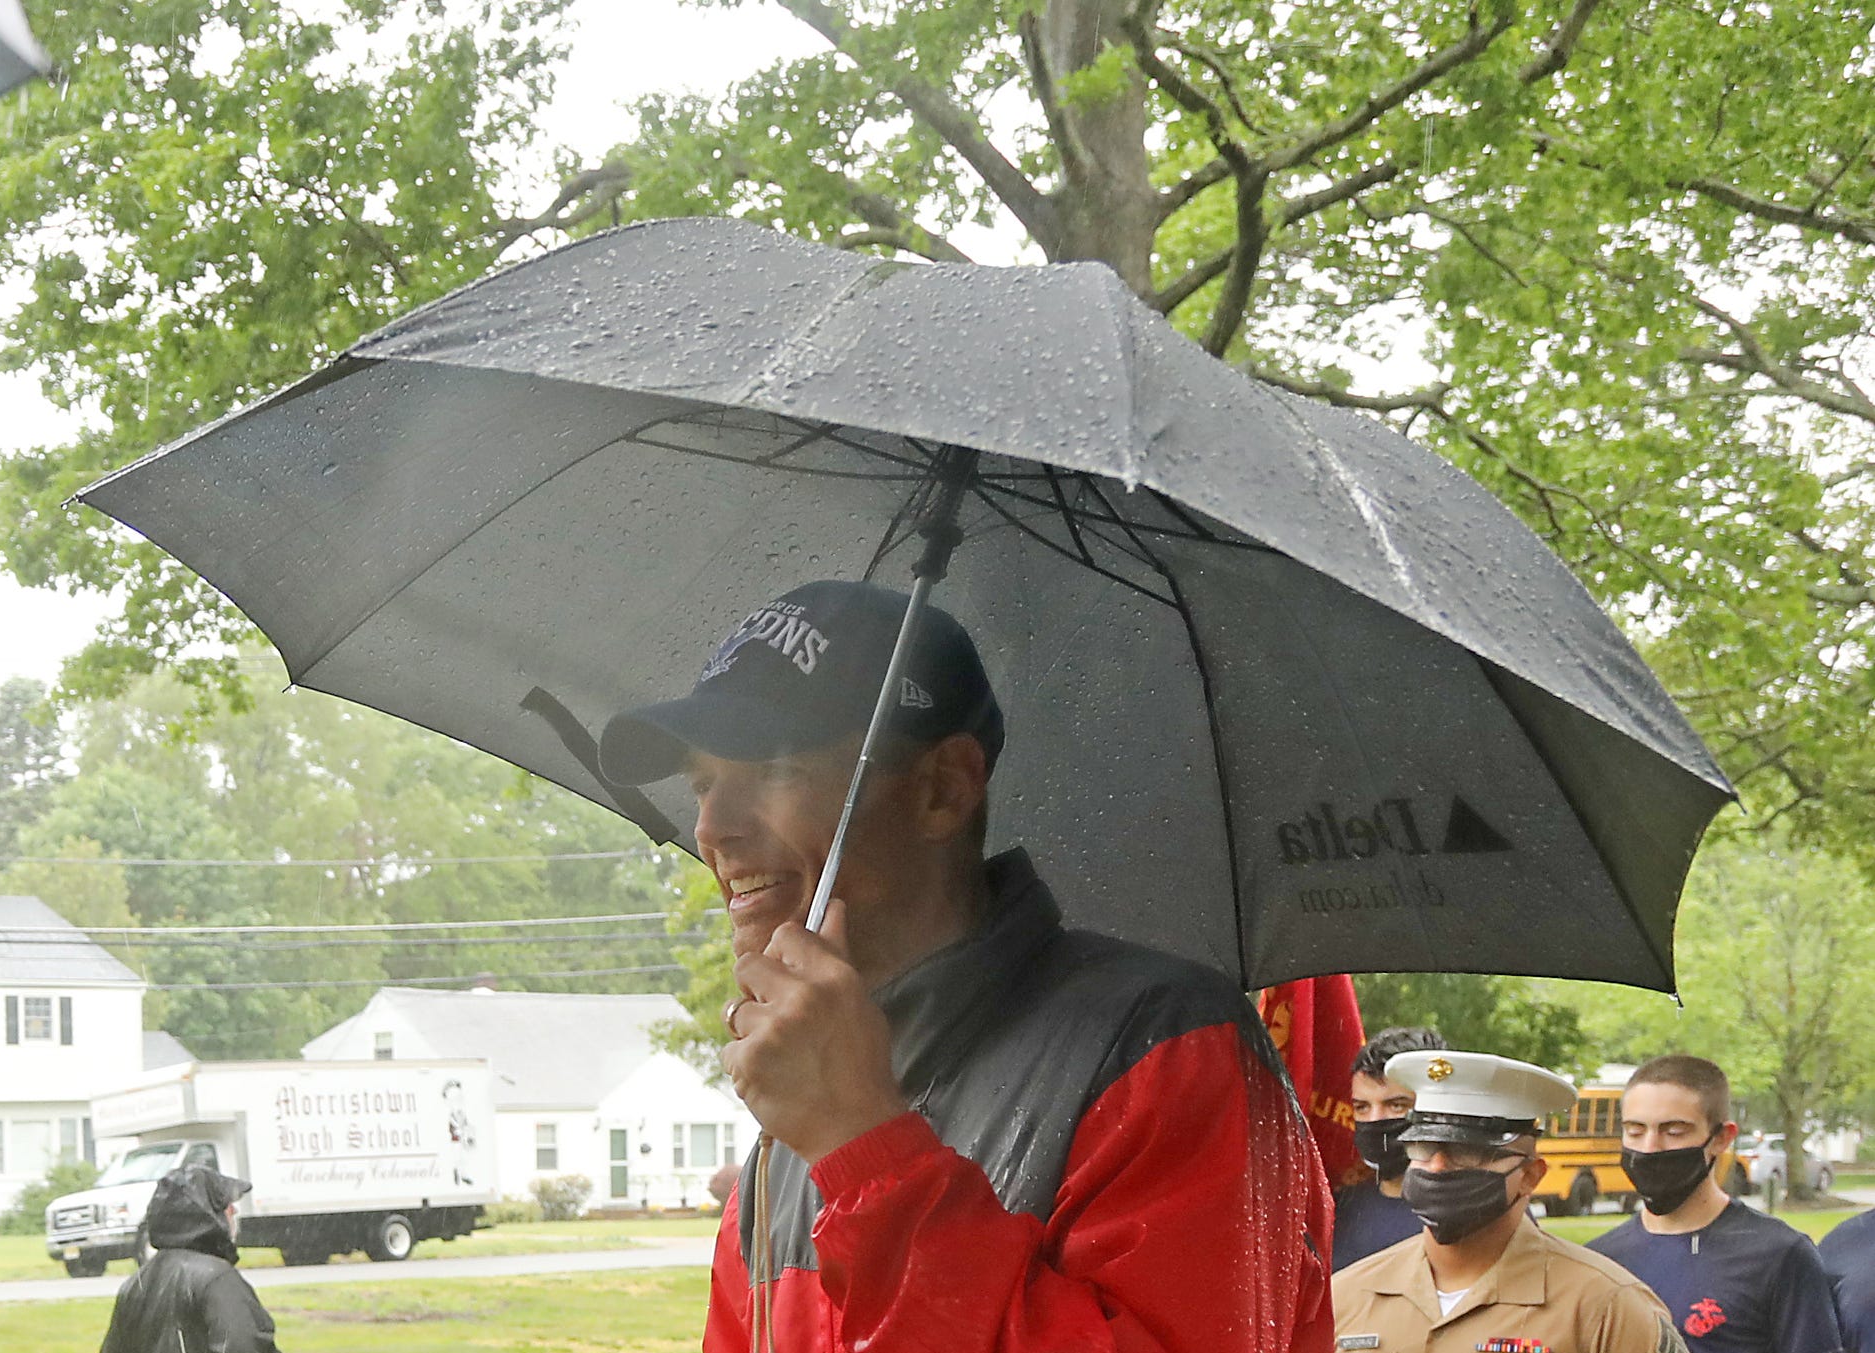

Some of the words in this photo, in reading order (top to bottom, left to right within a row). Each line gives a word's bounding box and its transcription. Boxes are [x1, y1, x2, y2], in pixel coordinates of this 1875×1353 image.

[275, 1086, 418, 1120] Morristown
[277, 1125, 334, 1156] High
[348, 1123, 421, 1149] School
[282, 1163, 365, 1189] Marching
[370, 1160, 441, 1181] Colonials
